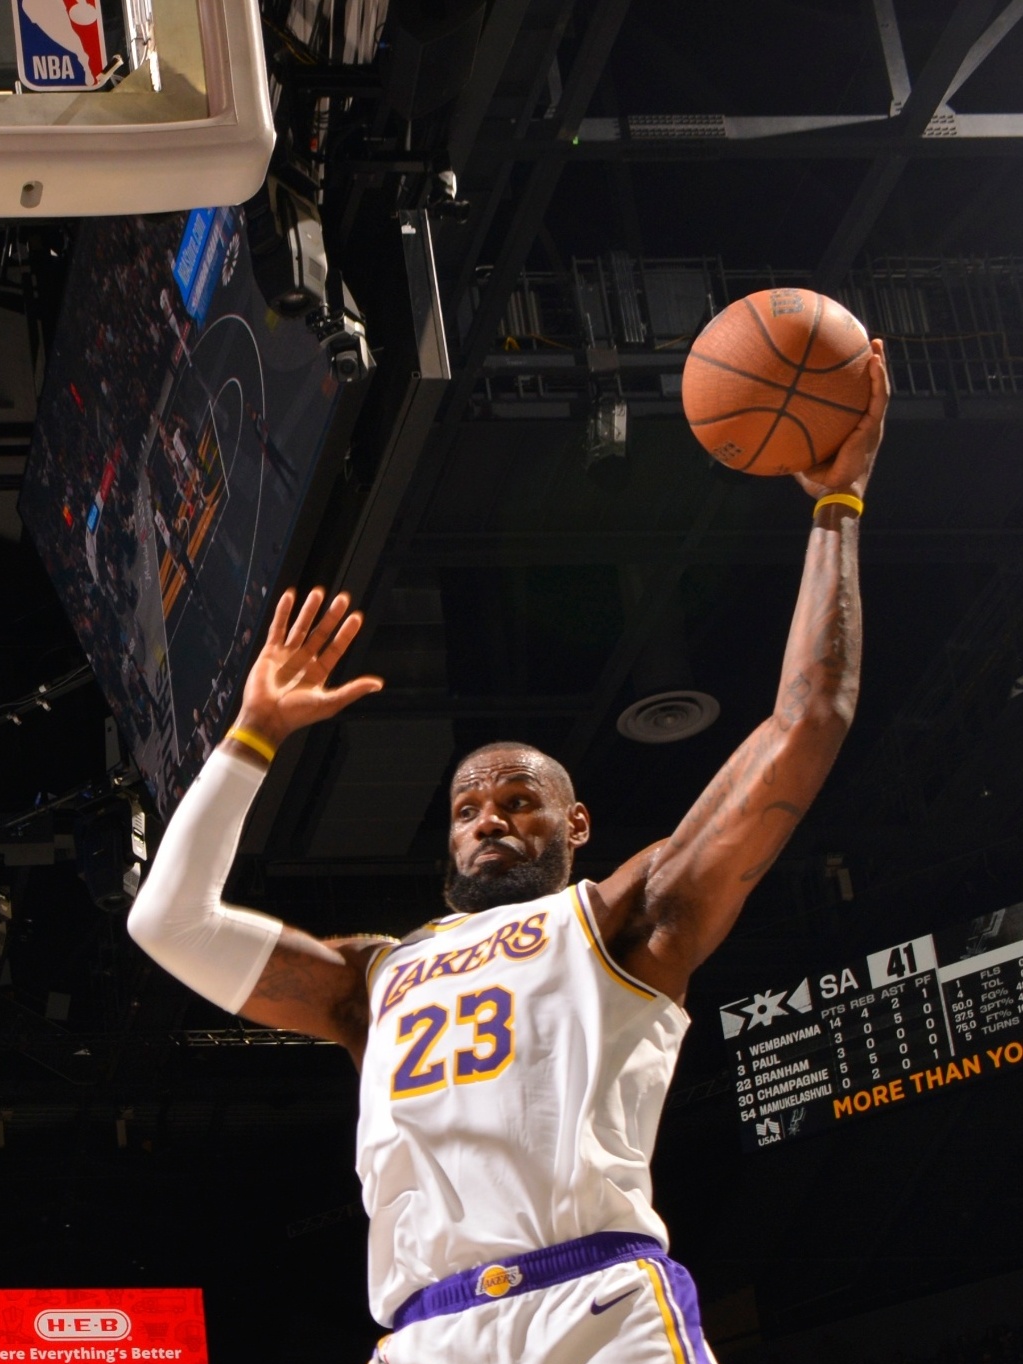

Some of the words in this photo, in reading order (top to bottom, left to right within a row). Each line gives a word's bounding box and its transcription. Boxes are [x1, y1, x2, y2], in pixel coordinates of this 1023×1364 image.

[32, 55, 75, 80] NBA
[377, 911, 550, 1027] LAKERS
[819, 968, 859, 999] SA
[886, 942, 918, 978] 41
[956, 980, 961, 988] 1
[980, 966, 1001, 980] FLS
[957, 990, 964, 998] 4
[981, 978, 1003, 990] TOL
[821, 1004, 846, 1019] PTS
[850, 994, 875, 1010] REB
[881, 983, 906, 999] AST
[915, 975, 931, 987] PF
[952, 1000, 973, 1012] 50.0
[981, 988, 1009, 1002] FG%
[955, 1011, 974, 1023] 37.5
[980, 998, 1014, 1014] 3PT%
[389, 983, 517, 1101] 23
[736, 1050, 742, 1060] 1
[749, 1024, 821, 1056] WEMBANYAMA
[829, 1017, 842, 1029] 14
[861, 1008, 869, 1018] 4
[891, 998, 900, 1009] 2
[922, 988, 928, 998] 1
[737, 1065, 746, 1076] 3
[752, 1054, 781, 1072] PAUL
[835, 1033, 843, 1044] 3
[864, 1023, 872, 1034] 0
[894, 1012, 902, 1024] 5
[923, 1003, 932, 1014] 0
[956, 1020, 977, 1033] 75.0
[986, 1009, 1012, 1023] FT%
[965, 1032, 972, 1041] 5
[981, 1016, 1020, 1035] TURNS
[736, 1079, 752, 1092] 22
[755, 1059, 810, 1086] BRANHAM
[837, 1048, 845, 1058] 3
[866, 1038, 874, 1049] 0
[896, 1028, 905, 1039] 0
[926, 1018, 935, 1029] 0
[738, 1094, 754, 1107] 30
[757, 1068, 829, 1101] CHAMPAGNIE
[840, 1063, 848, 1074] 5
[869, 1053, 877, 1064] 5
[899, 1043, 908, 1054] 0
[928, 1034, 937, 1045] 0
[741, 1108, 756, 1122] 54
[759, 1083, 833, 1116] MAMUKELASHVILI
[842, 1078, 851, 1089] 0
[872, 1068, 881, 1080] 2
[902, 1058, 911, 1069] 0
[933, 1049, 939, 1060] 1
[833, 1079, 906, 1119] MORE
[909, 1054, 982, 1093] THAN
[758, 1134, 781, 1147] USAA
[30, 1347, 127, 1364] Everything's
[131, 1347, 182, 1360] Better
